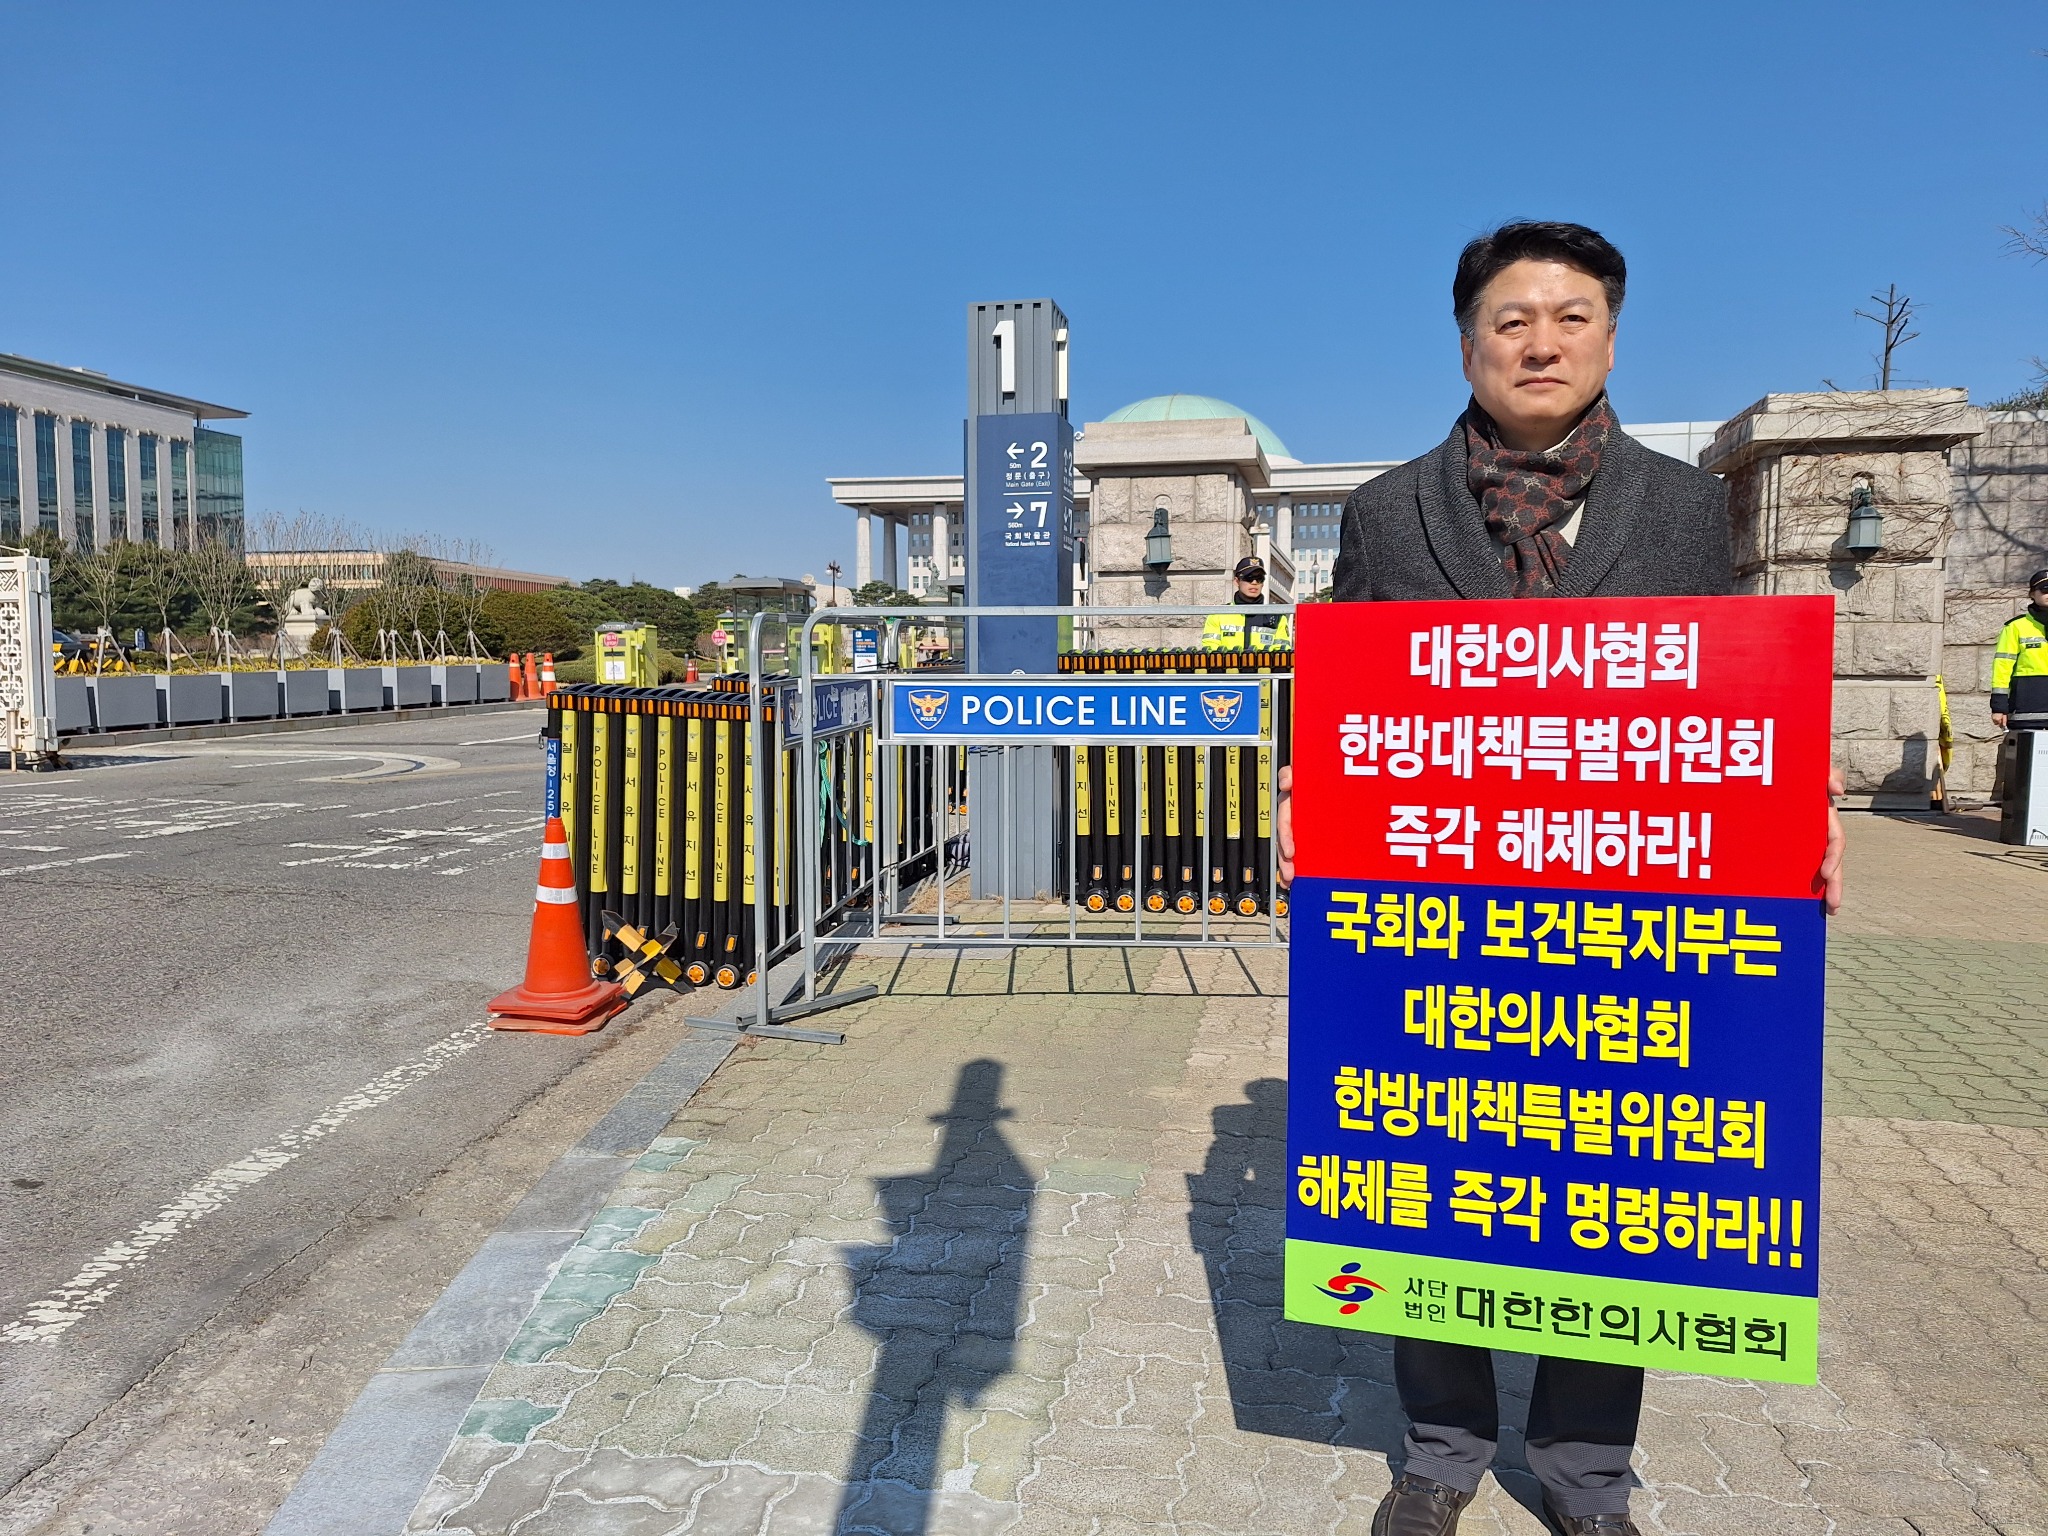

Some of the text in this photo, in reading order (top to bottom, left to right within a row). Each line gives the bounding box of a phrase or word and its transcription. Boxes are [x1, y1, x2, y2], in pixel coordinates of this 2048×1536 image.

[992, 320, 1015, 392] 1
[1030, 441, 1048, 468] 2
[1036, 480, 1051, 488] (Exit)
[1030, 501, 1048, 528] 7
[1410, 621, 1699, 690] 대한의사협회
[962, 695, 1187, 726] POLICE LINE
[1339, 714, 1774, 786] 한방대책특별위원회
[592, 745, 603, 874] POLICE LINE
[656, 748, 668, 877] POLICE LINE
[715, 753, 726, 883] POLICE LINE
[1108, 776, 1117, 819] LINE
[1168, 776, 1176, 819] LINE
[1229, 777, 1238, 820] LINE
[1385, 805, 1712, 880] 즉각 해체하라!
[1326, 890, 1783, 977] 국회와 보건복지부는
[1405, 985, 1690, 1068] 대한의사협회
[1335, 1067, 1766, 1169] 한방대책특별위원회
[1297, 1155, 1804, 1270] 해체를 즉각 명령하라!!
[1403, 1277, 1449, 1300] 사단
[1404, 1301, 1447, 1325] 법인
[1456, 1285, 1788, 1362] 대한한의사협회
